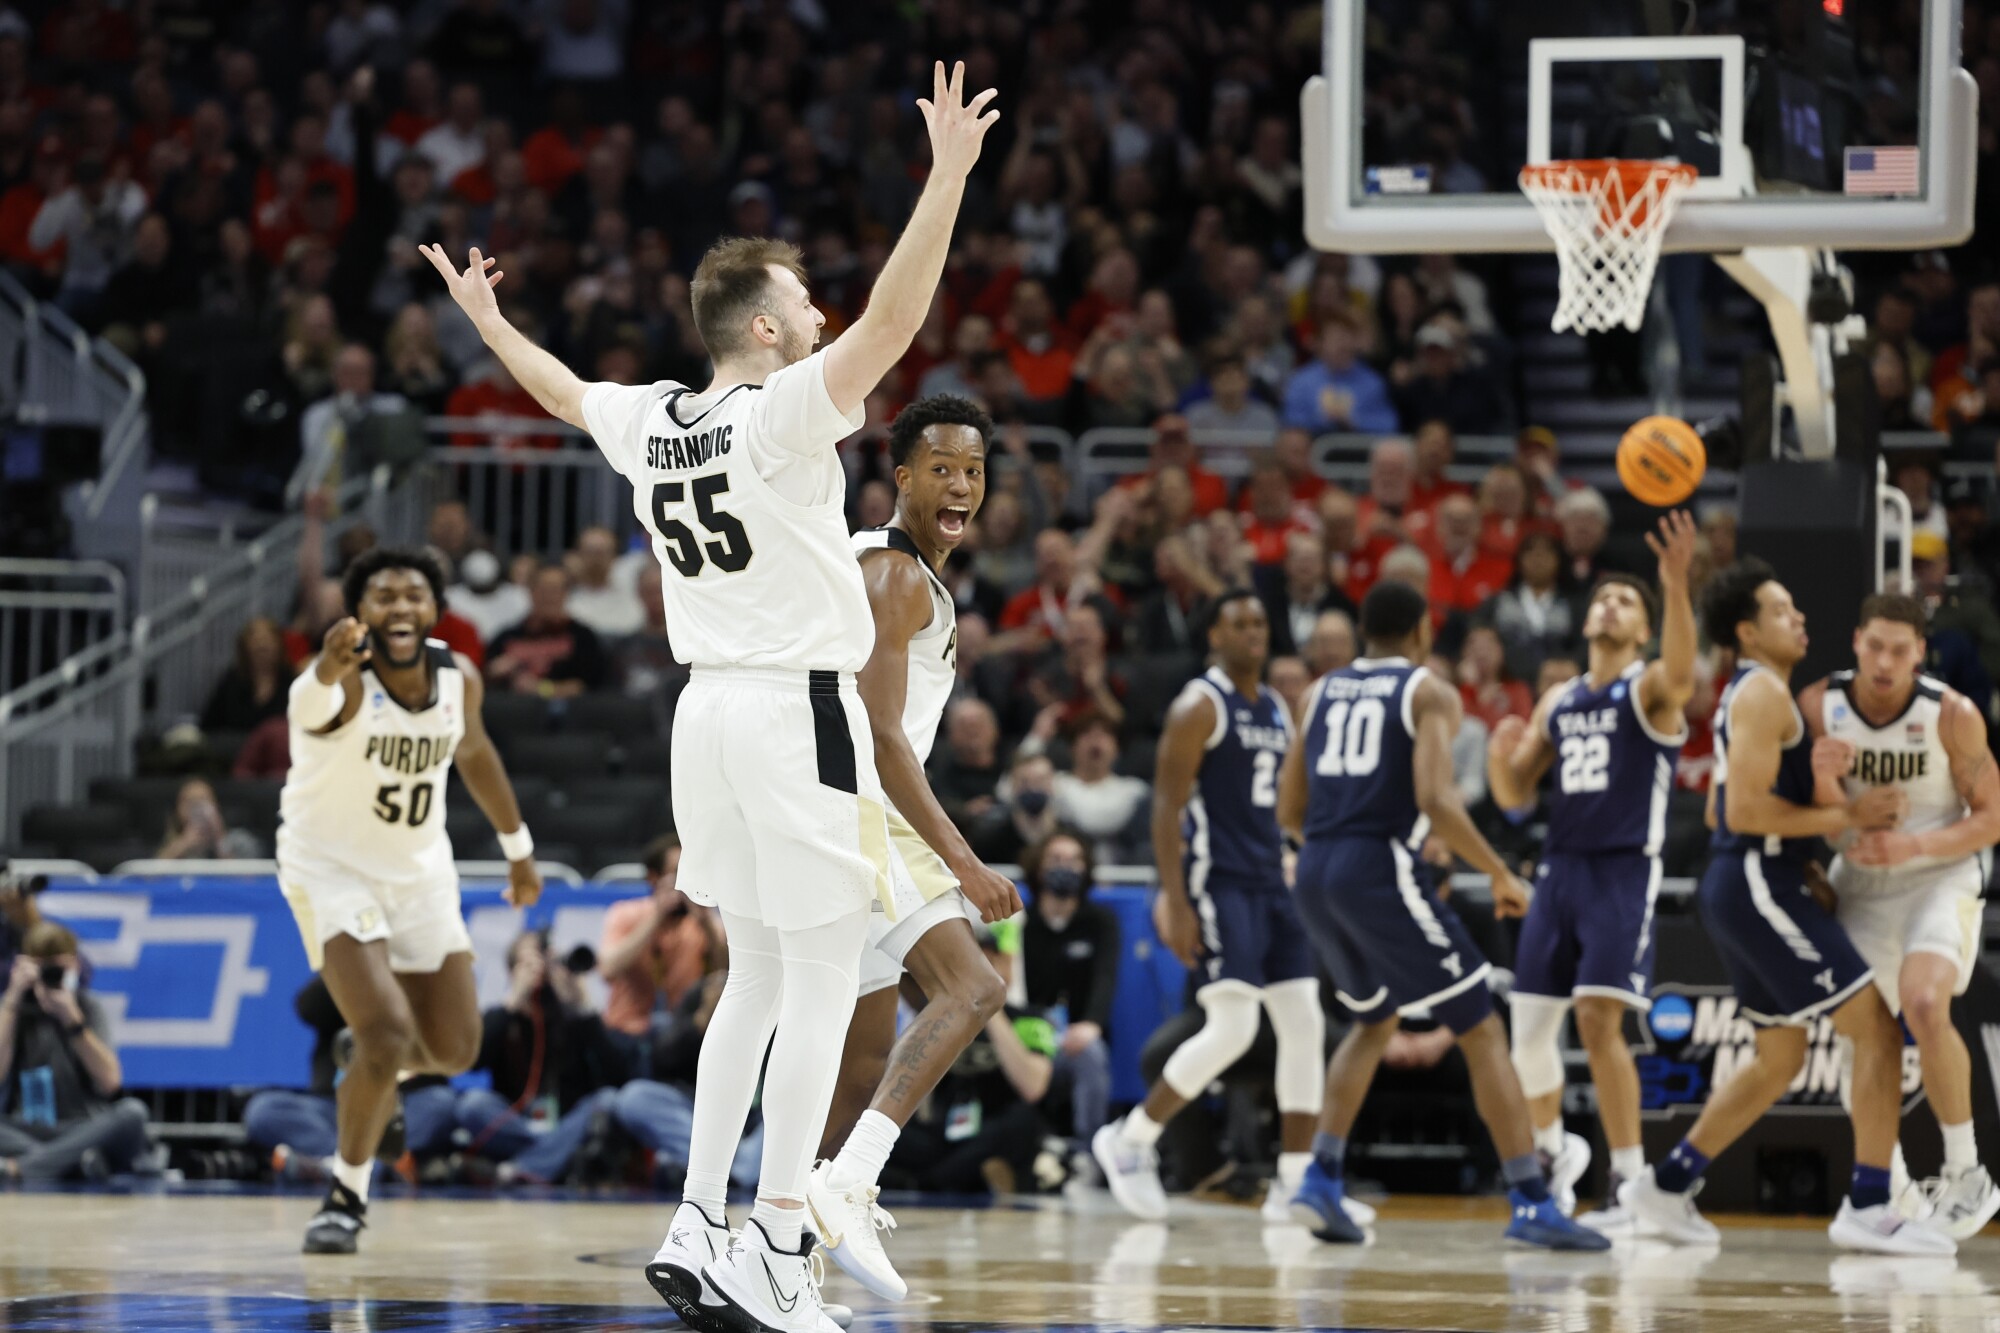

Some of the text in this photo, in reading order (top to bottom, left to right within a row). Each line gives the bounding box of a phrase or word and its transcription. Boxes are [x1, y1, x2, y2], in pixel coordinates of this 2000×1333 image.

[647, 424, 733, 470] STEFANOVIC
[651, 472, 753, 578] 55
[1316, 698, 1385, 776] 10
[1557, 708, 1618, 737] YALE
[365, 735, 452, 774] PURDU
[1559, 735, 1610, 793] 22
[1849, 749, 1929, 787] RDUE
[1251, 750, 1277, 807] 2
[373, 782, 433, 827] 50
